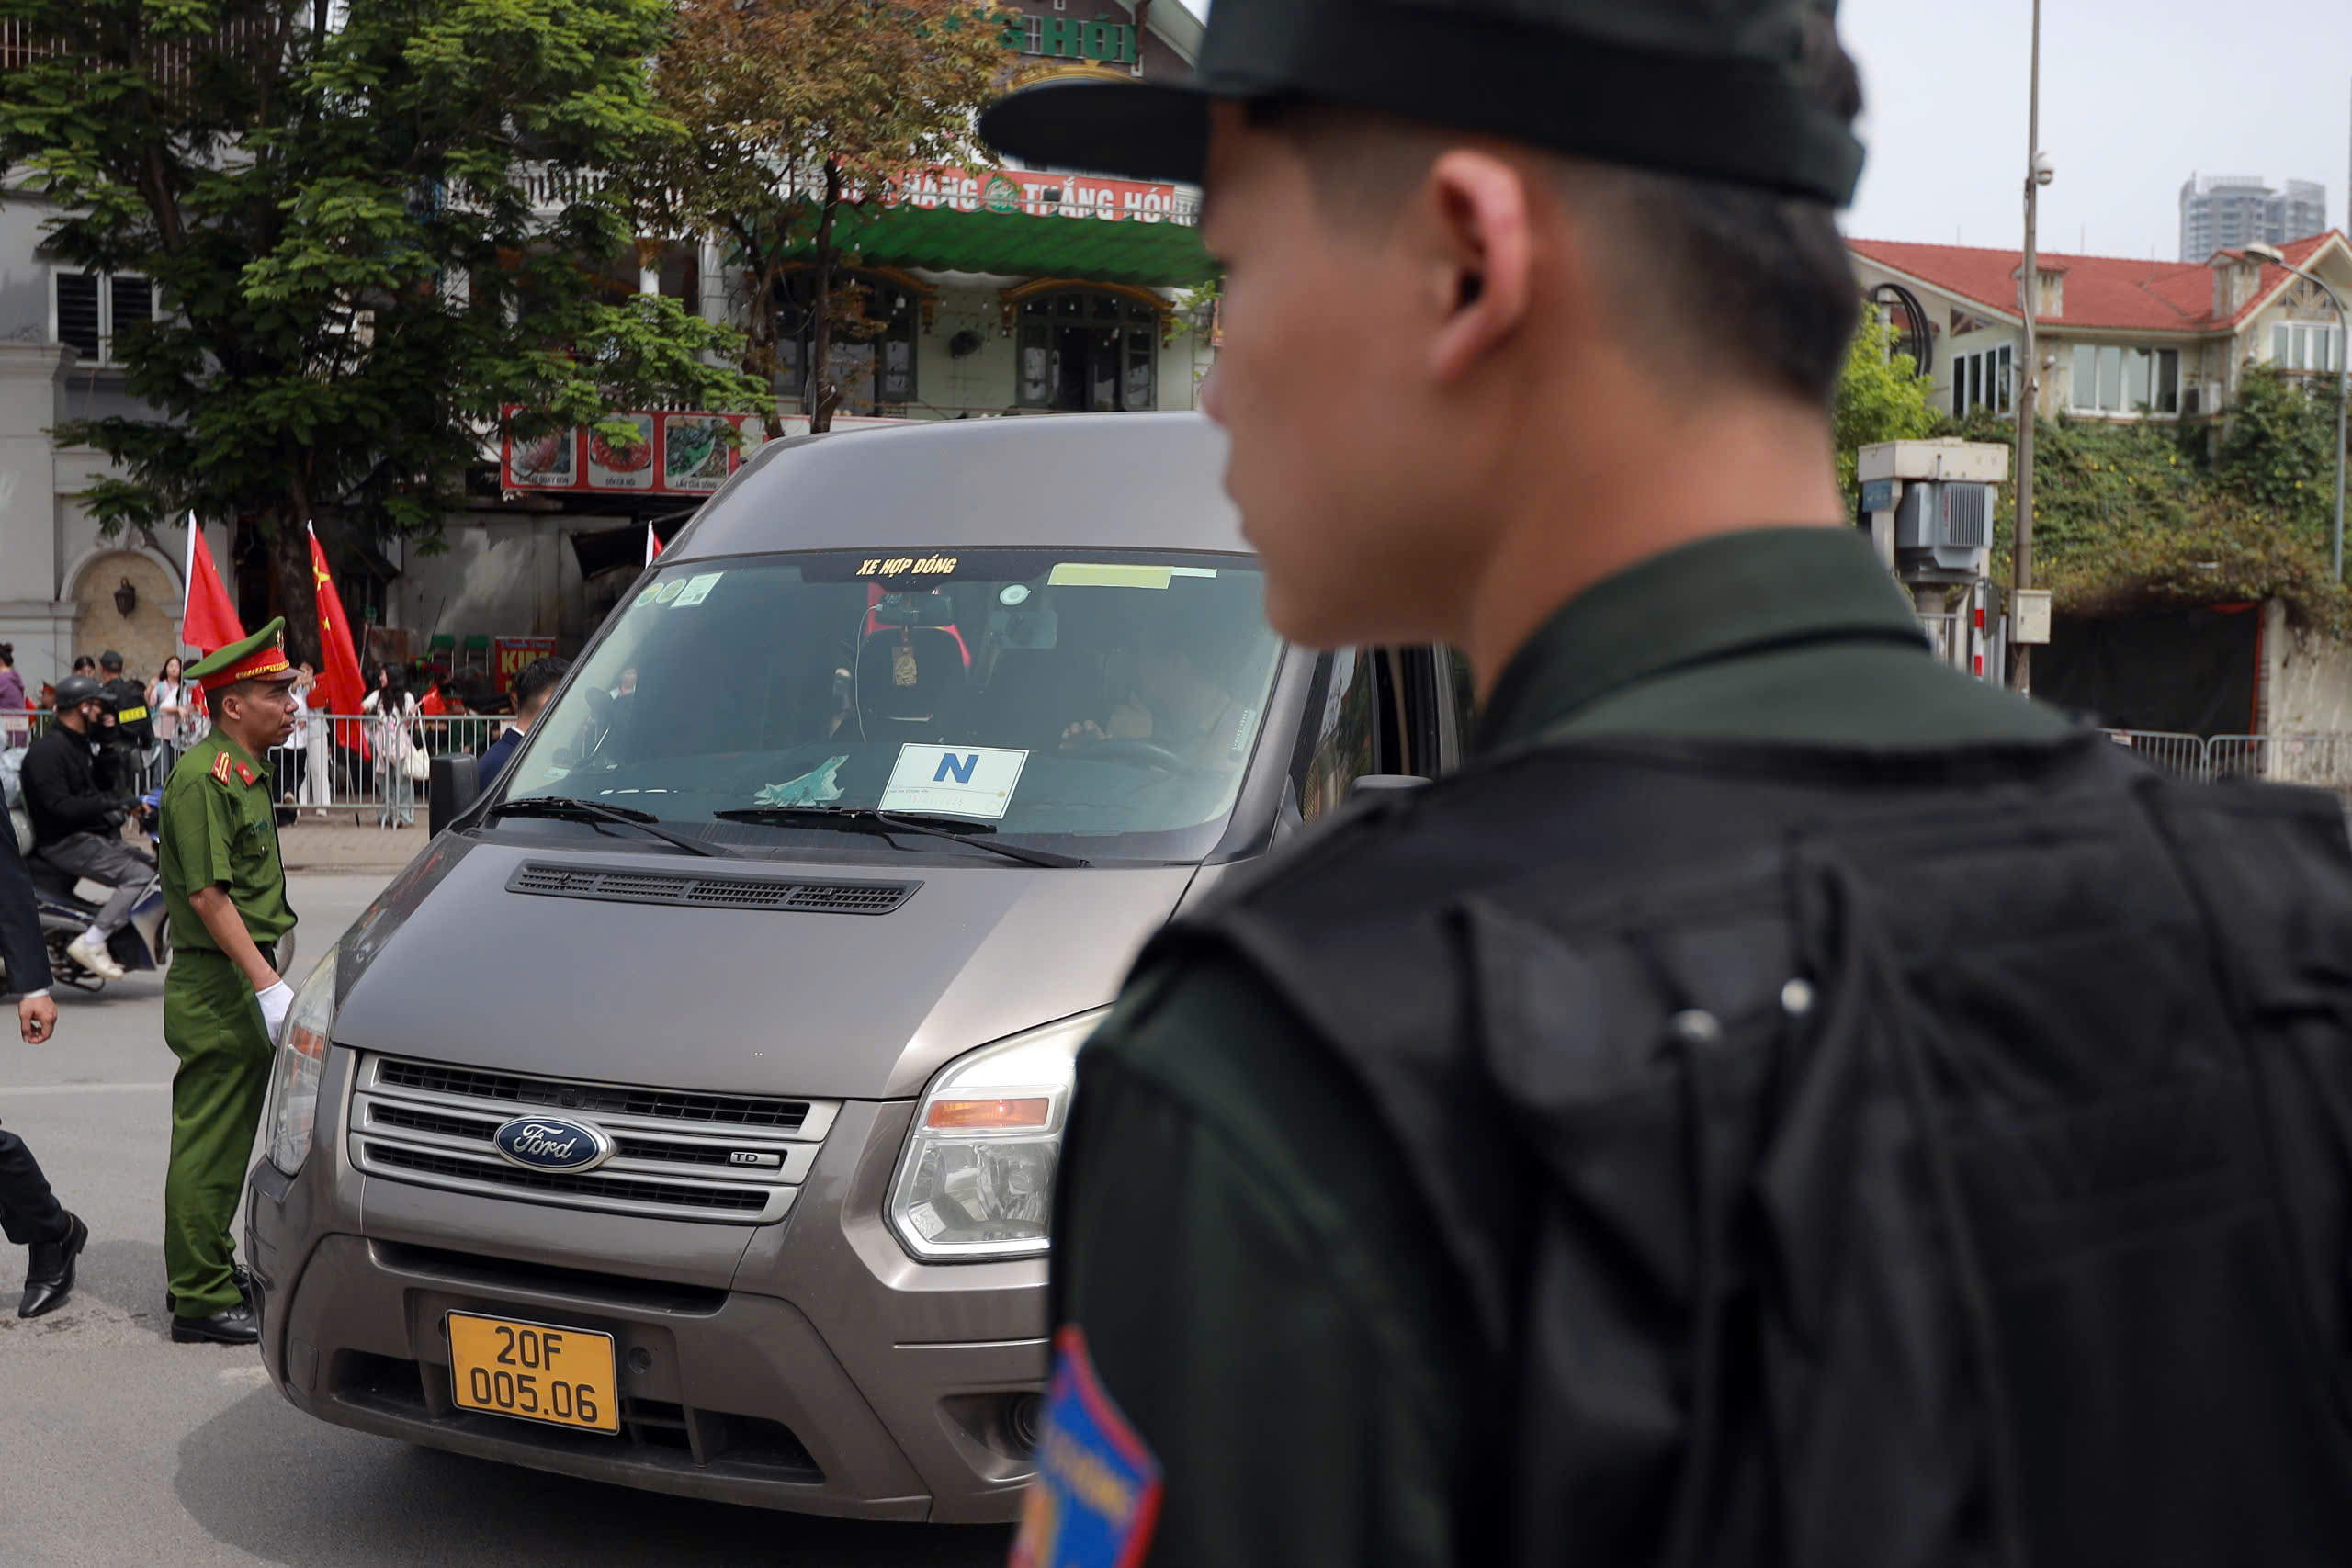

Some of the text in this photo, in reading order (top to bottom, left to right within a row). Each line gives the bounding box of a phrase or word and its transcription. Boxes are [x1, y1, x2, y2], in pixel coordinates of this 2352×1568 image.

[1124, 187, 1171, 224] HÓI
[855, 558, 882, 576] XE
[878, 557, 913, 578] HỢP
[933, 752, 979, 784] N
[513, 1123, 579, 1159] Ford
[733, 1152, 759, 1163] TD
[494, 1325, 563, 1371] 20F
[469, 1367, 598, 1423] 005.06
